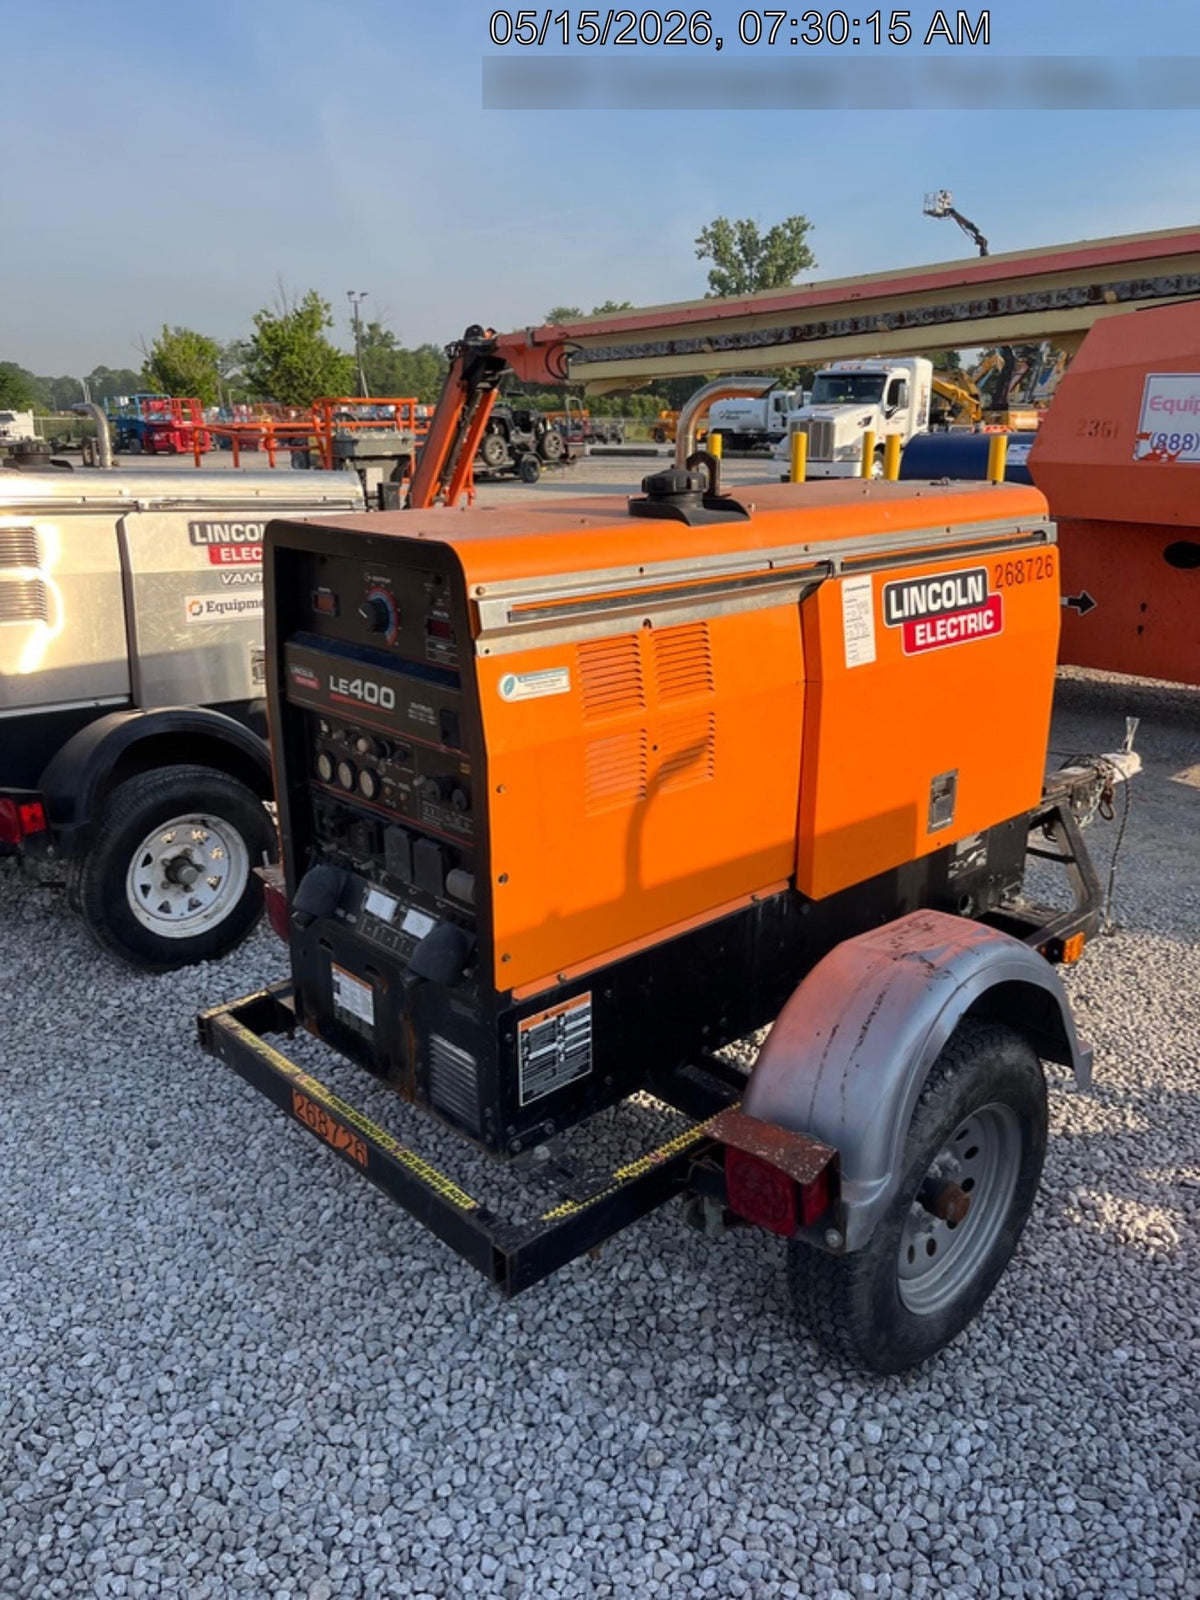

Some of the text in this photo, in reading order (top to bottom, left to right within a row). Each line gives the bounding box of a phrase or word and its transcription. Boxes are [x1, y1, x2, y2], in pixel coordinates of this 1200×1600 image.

[995, 555, 1053, 589] 268726
[206, 599, 264, 614] Equipm
[890, 574, 983, 620] LINCOLN
[914, 609, 994, 647] ELECTRIC
[329, 675, 395, 710] LE400
